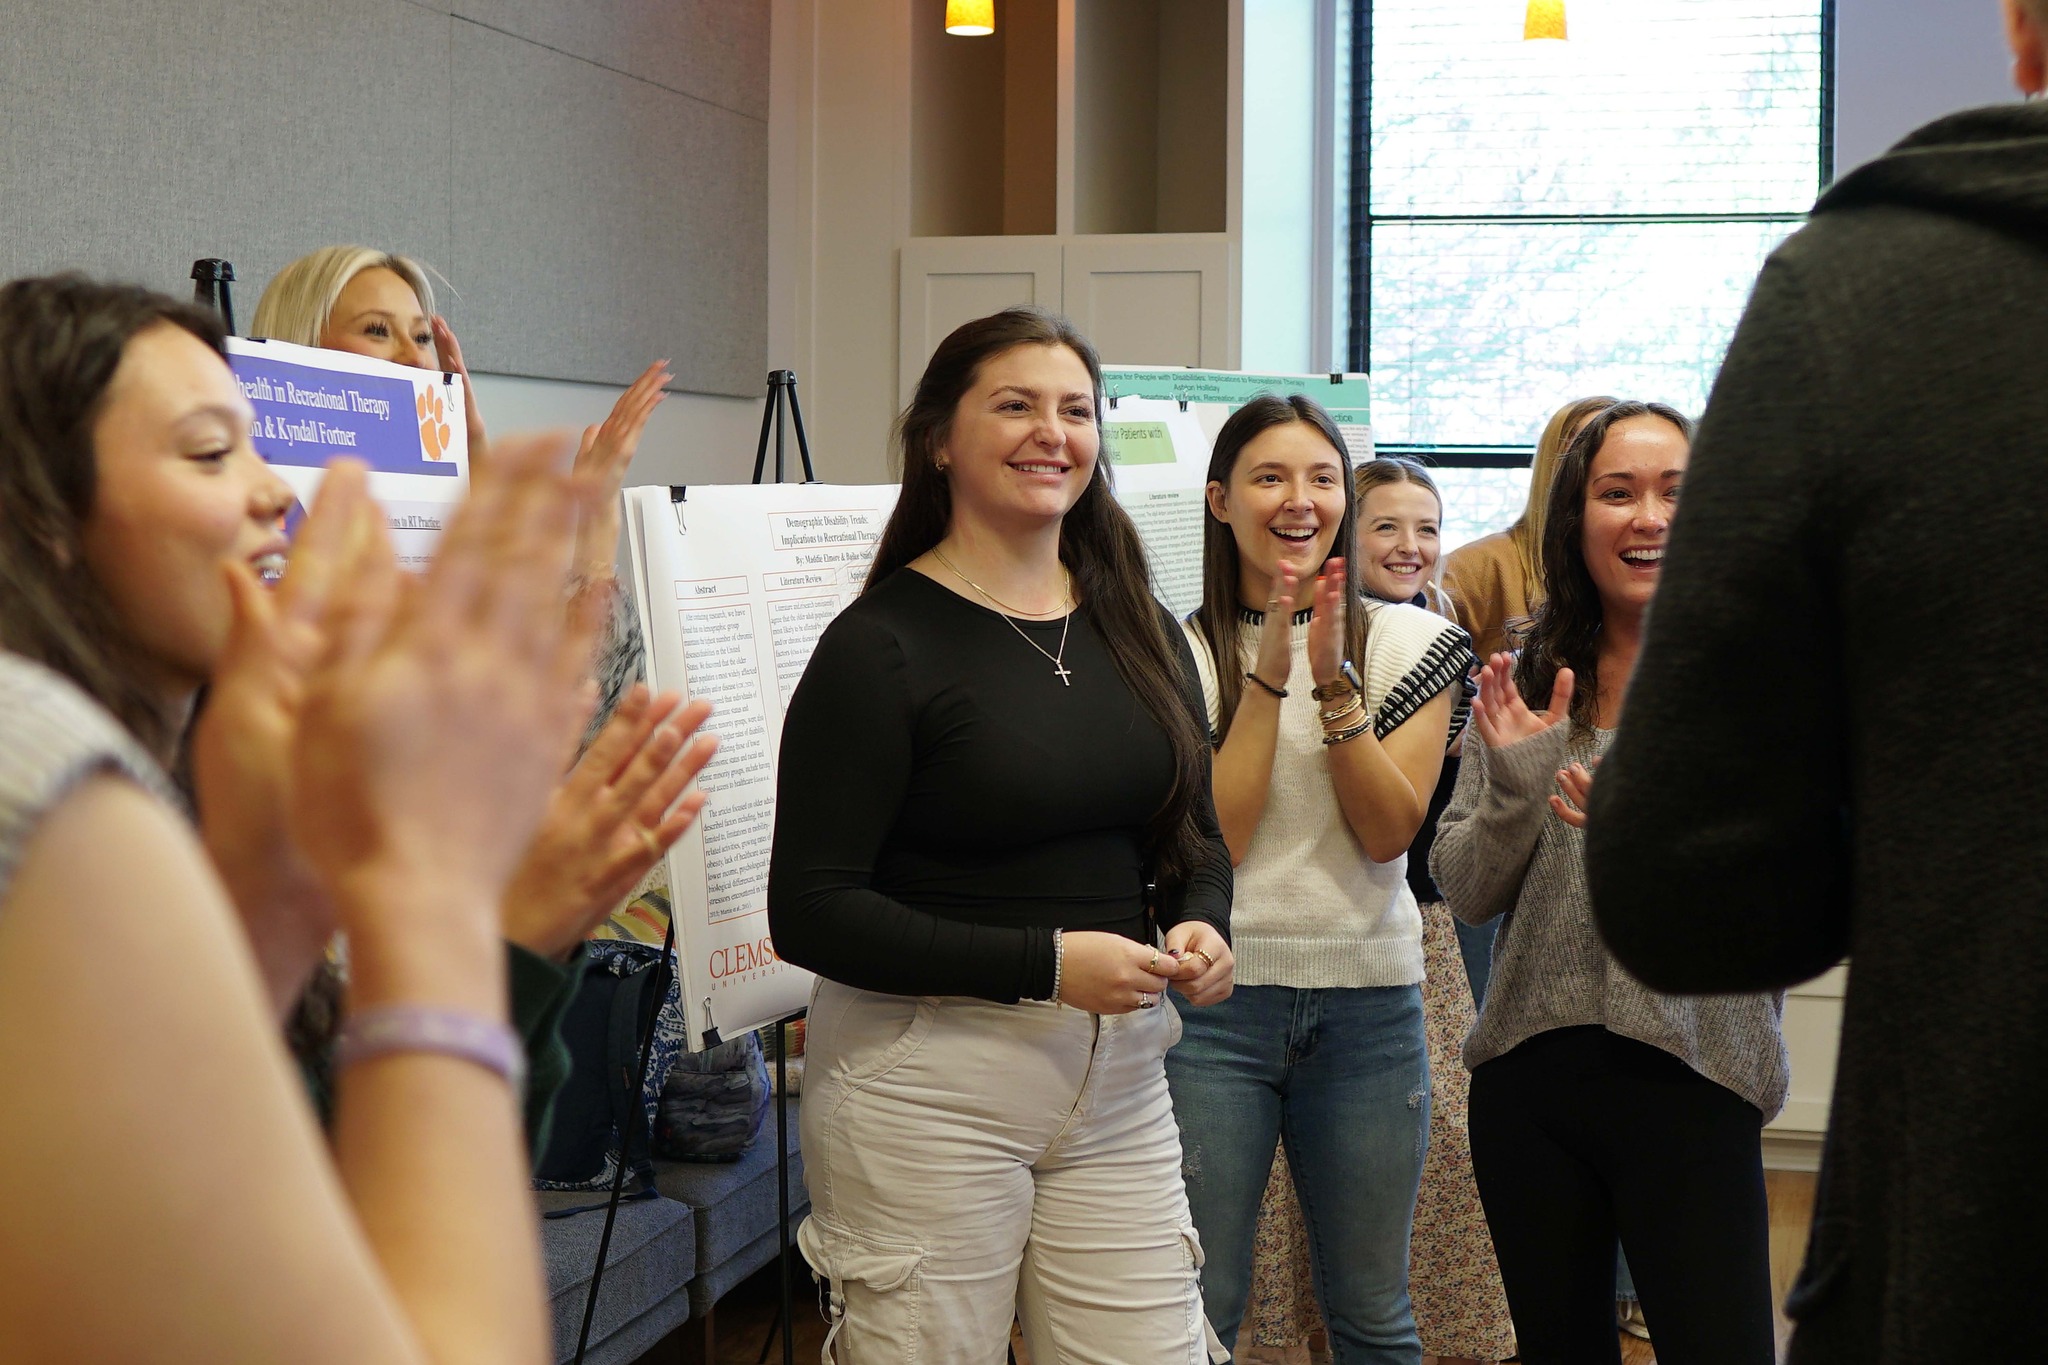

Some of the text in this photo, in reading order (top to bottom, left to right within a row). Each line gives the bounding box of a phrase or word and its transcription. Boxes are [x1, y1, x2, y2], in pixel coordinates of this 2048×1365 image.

[1134, 374, 1156, 382] People
[1283, 378, 1305, 387] Therapy
[274, 379, 286, 403] in
[285, 381, 348, 411] Recreational
[348, 390, 390, 421] Therapy
[1334, 413, 1353, 422] ctice
[265, 415, 276, 439] &
[276, 416, 319, 446] Kyndall
[318, 422, 357, 446] Fortner
[1120, 427, 1147, 439] Patients
[1148, 426, 1163, 438] with
[408, 516, 417, 527] RT
[786, 517, 824, 529] Demographic
[824, 516, 848, 527] Disability
[781, 534, 816, 547] Implications
[817, 534, 823, 542] to
[824, 531, 857, 542] Recreational
[780, 574, 822, 586] Literature Review
[708, 809, 717, 818] The
[710, 937, 782, 978] CLEMS
